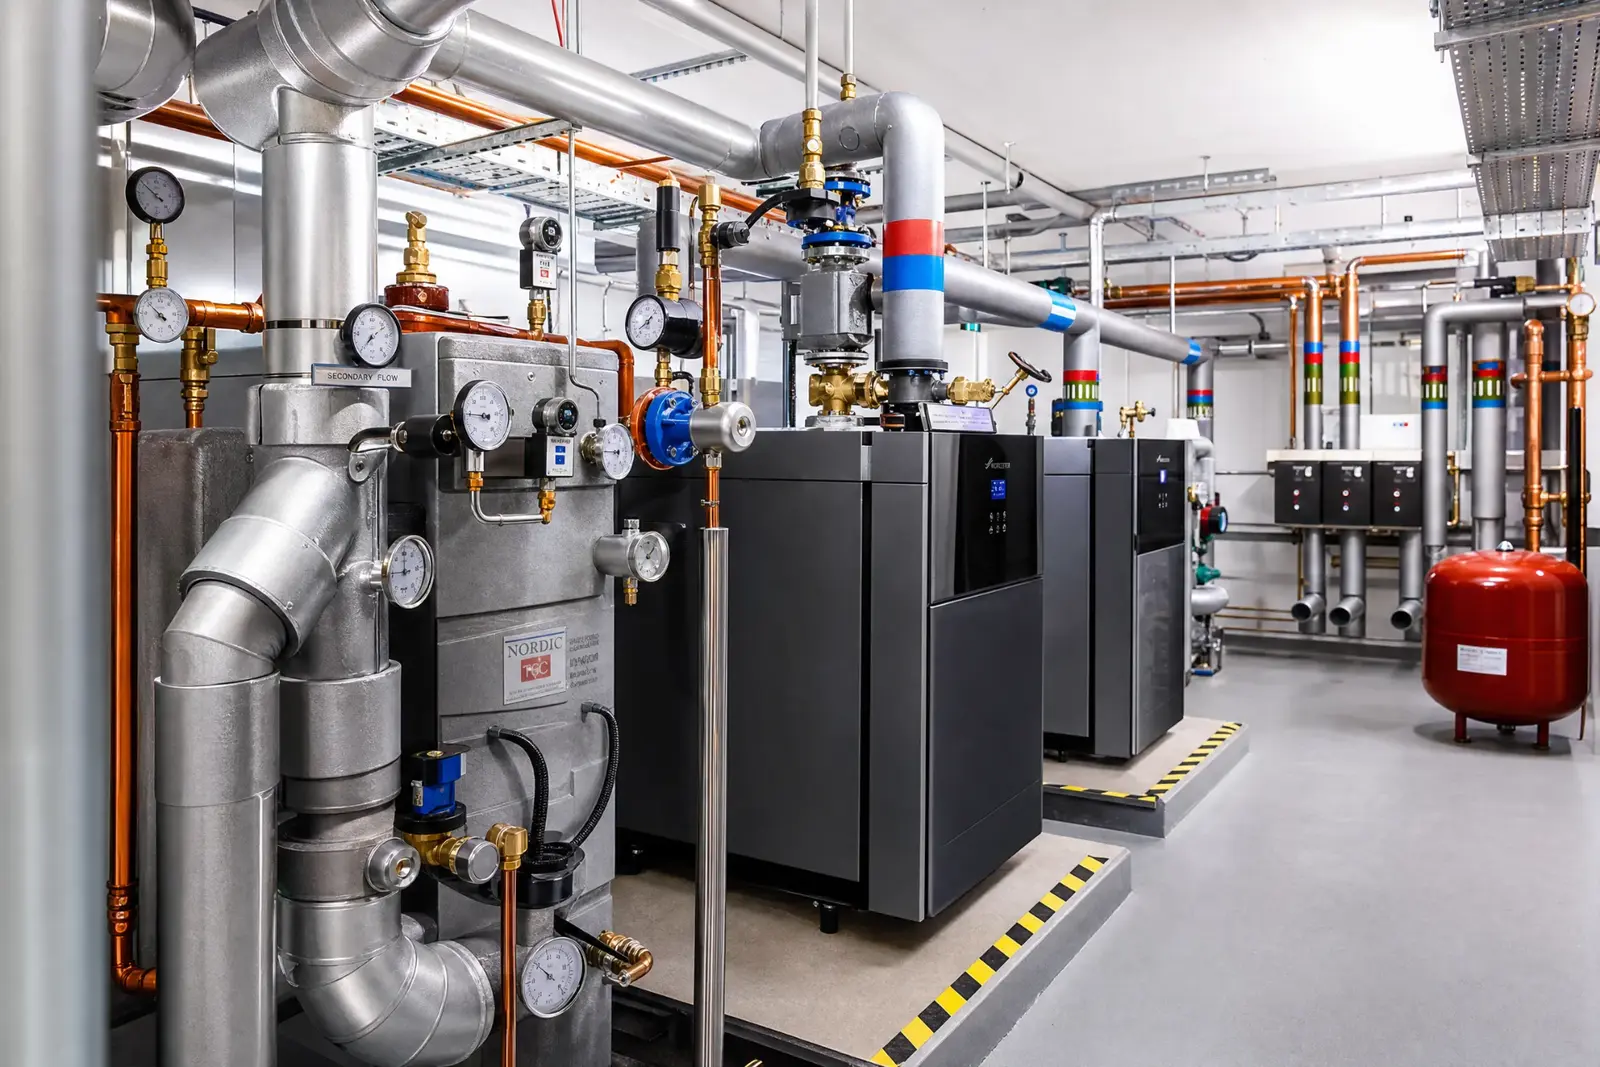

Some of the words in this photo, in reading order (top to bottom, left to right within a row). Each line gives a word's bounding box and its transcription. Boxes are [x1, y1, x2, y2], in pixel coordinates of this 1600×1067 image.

[327, 371, 373, 381] SECONDARY
[377, 374, 399, 382] FLOW
[507, 637, 563, 658] NORDIC
